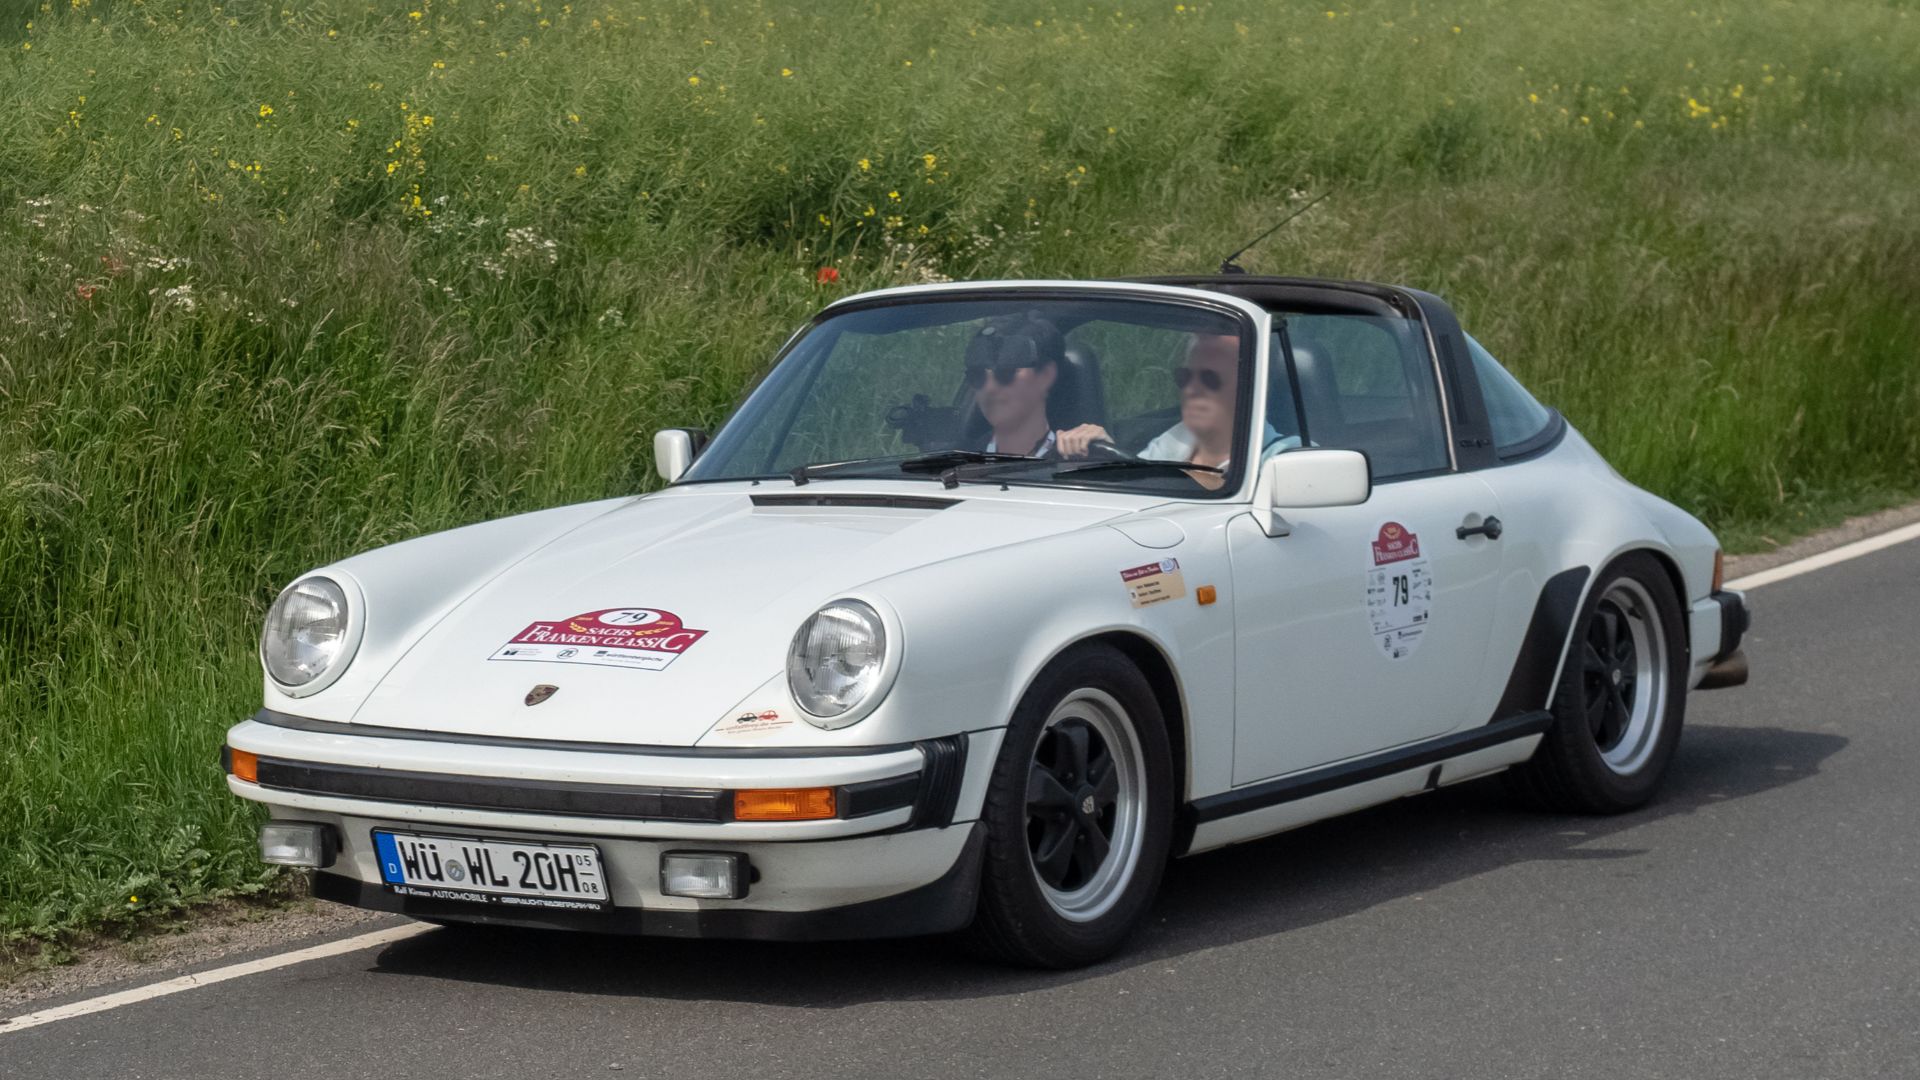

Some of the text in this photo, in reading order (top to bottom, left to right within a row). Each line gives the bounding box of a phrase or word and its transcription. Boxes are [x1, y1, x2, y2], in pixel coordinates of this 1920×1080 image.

[1393, 575, 1408, 607] 79
[611, 612, 648, 623] 79
[518, 625, 695, 651] FRANKEN CLASSIC
[586, 627, 635, 637] SACHS
[398, 841, 581, 892] WÜ WL 20H
[575, 855, 592, 866] 05
[389, 862, 398, 874] D
[583, 881, 598, 894] 08
[432, 890, 488, 902] AUTOMOBILE
